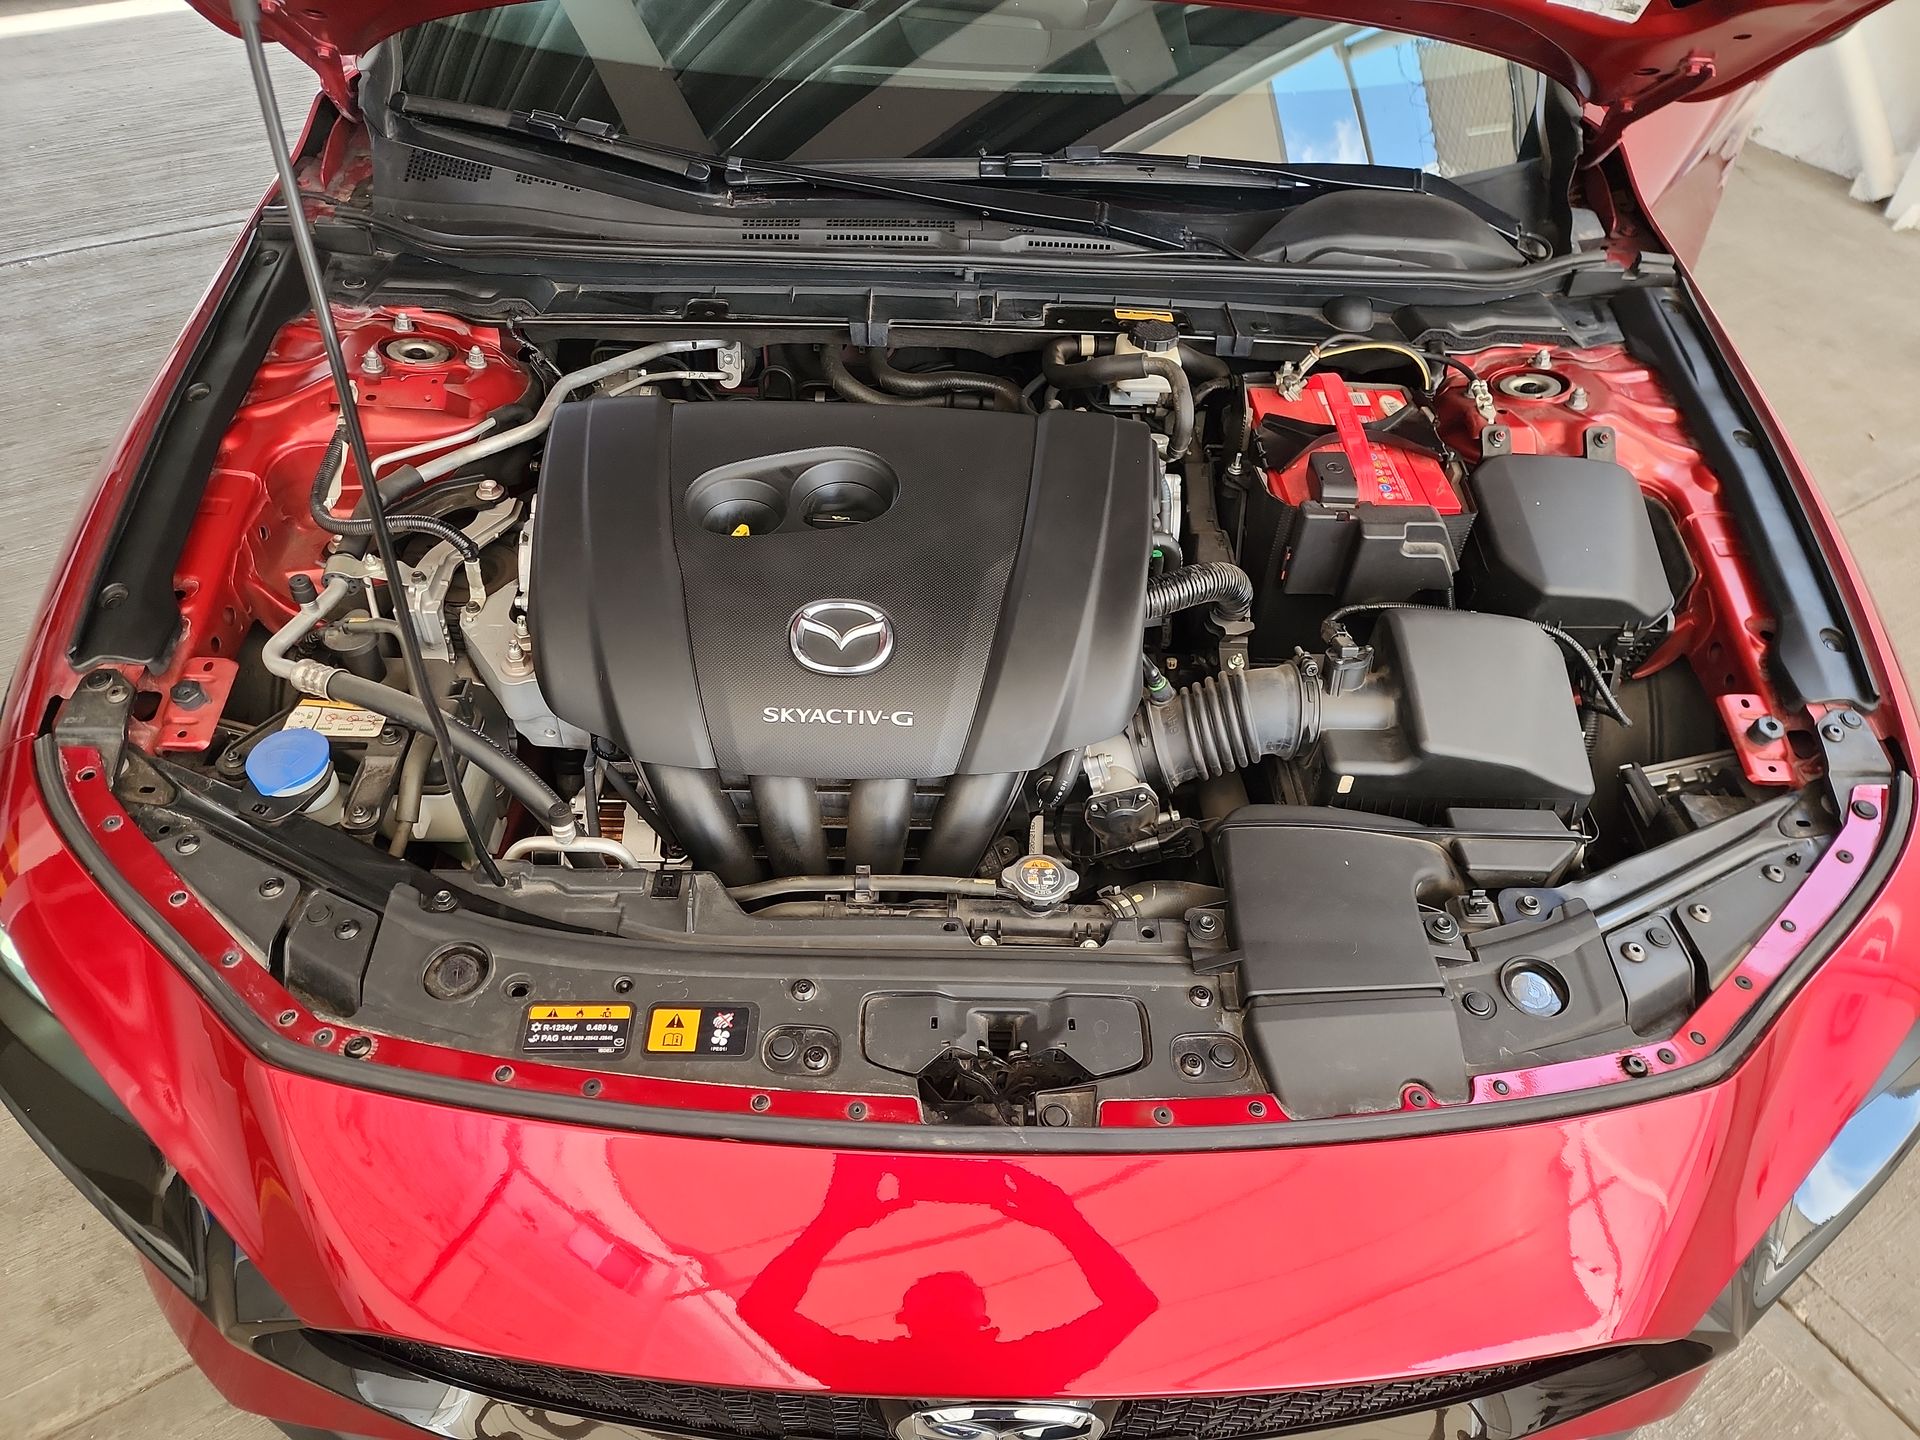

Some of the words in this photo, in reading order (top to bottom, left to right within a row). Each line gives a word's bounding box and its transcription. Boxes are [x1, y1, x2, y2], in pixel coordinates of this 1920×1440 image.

[762, 707, 914, 727] SKYACTIV-G
[543, 1023, 578, 1033] R-1234yf
[586, 1024, 607, 1032] 0.480
[608, 1023, 618, 1033] kg
[541, 1034, 559, 1042] PAG
